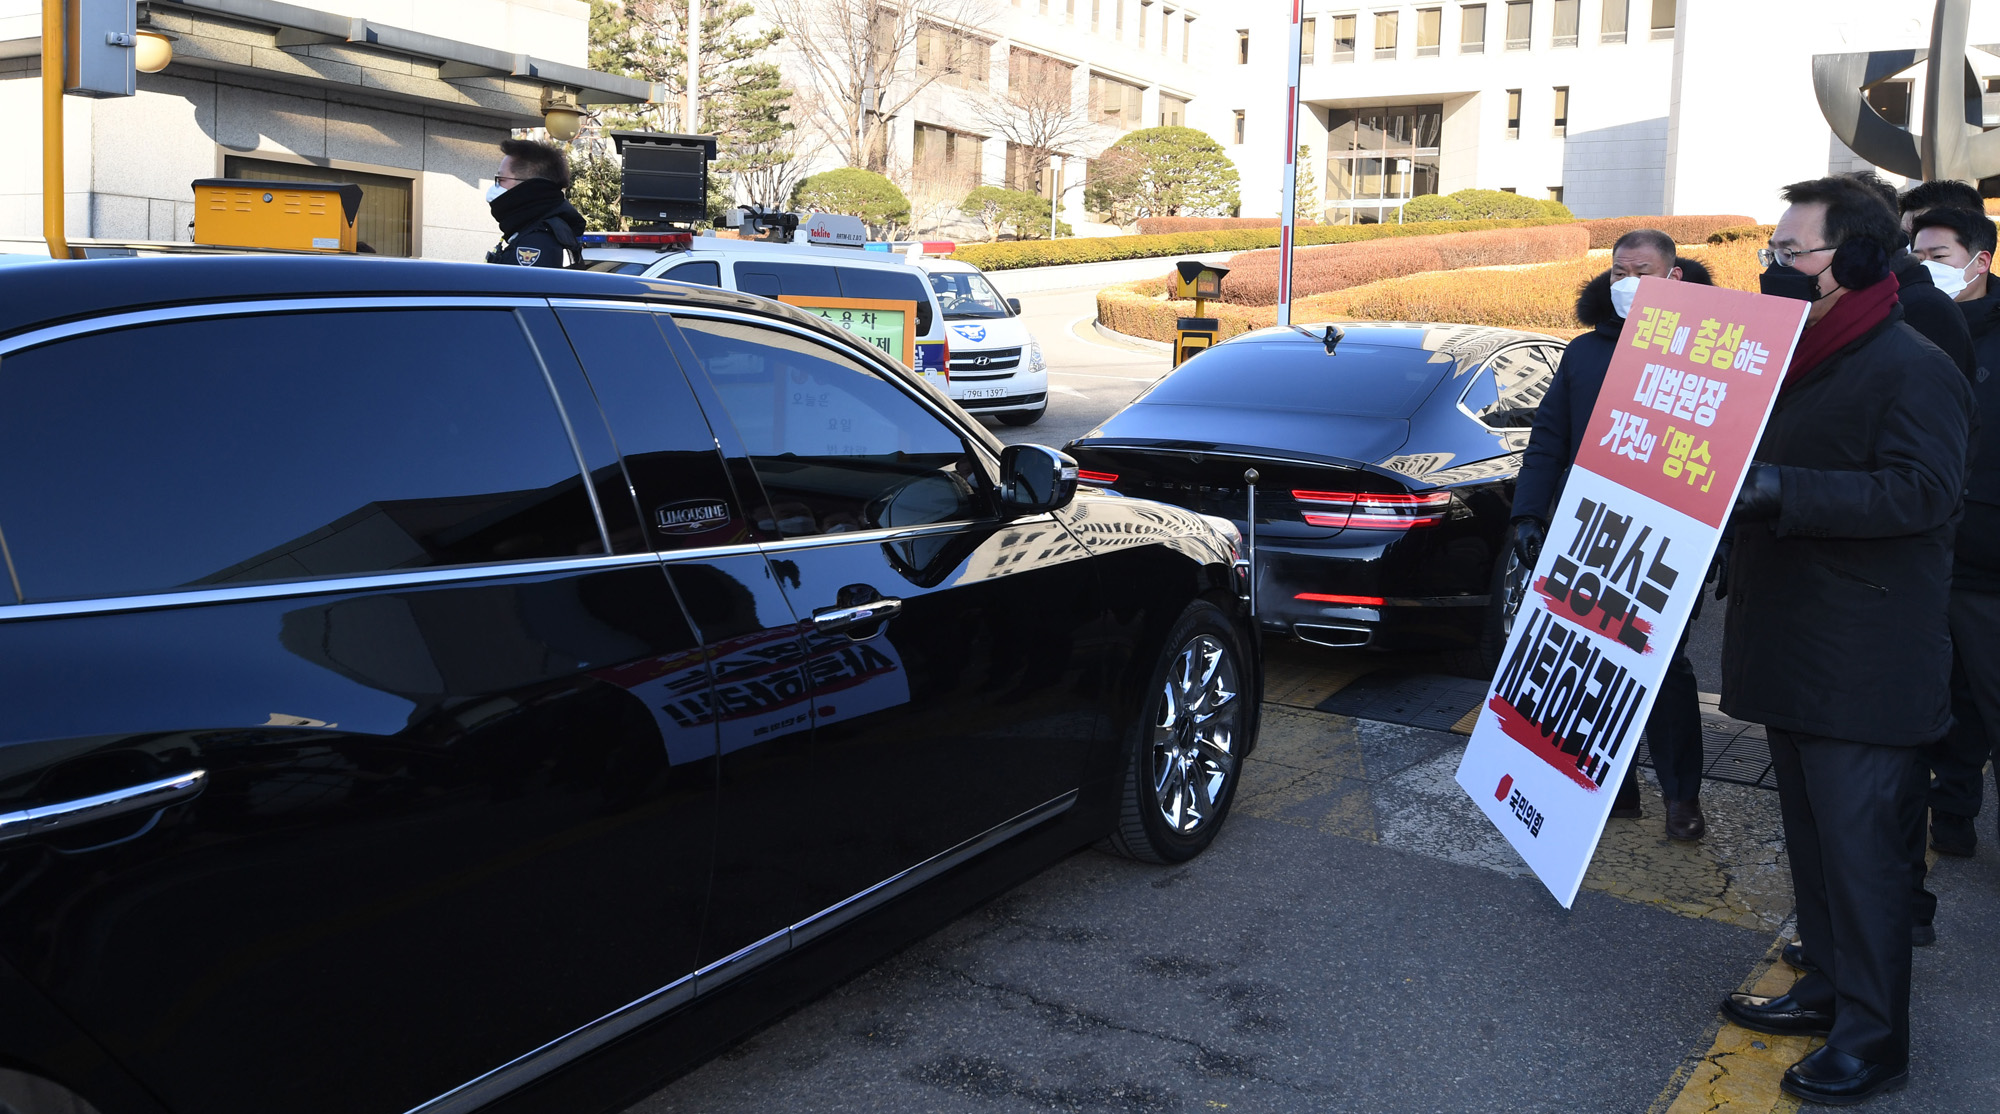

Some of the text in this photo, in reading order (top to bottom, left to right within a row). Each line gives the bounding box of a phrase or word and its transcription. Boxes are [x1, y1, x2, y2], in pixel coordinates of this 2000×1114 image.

[810, 226, 831, 239] Teklite
[1631, 306, 1770, 376] 권력에 충성하는
[985, 389, 1004, 398] 1397
[1632, 362, 1728, 428] 대법원장
[1598, 408, 1658, 464] 거짓의
[659, 504, 726, 525] LIMOUSINE
[1543, 497, 1680, 655] 김명수는
[1494, 607, 1648, 788] 사퇴하라!!
[1509, 788, 1545, 839] 국민의힘
